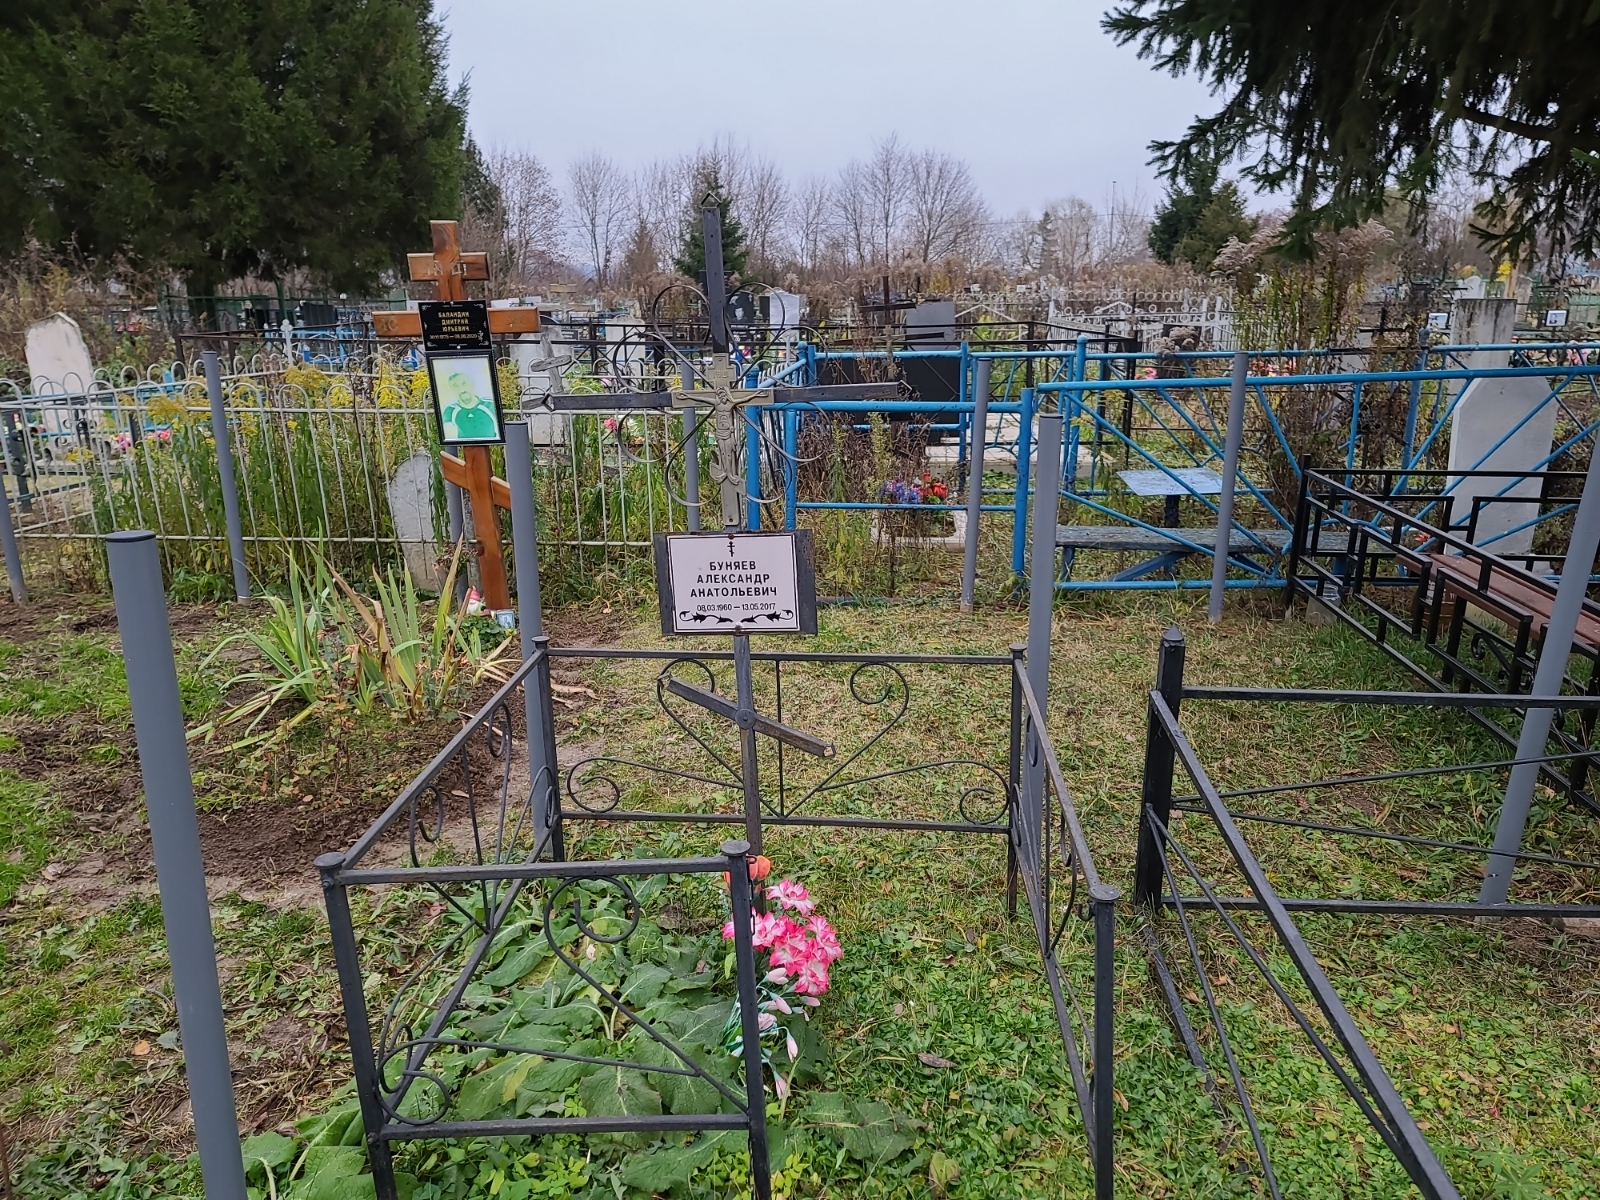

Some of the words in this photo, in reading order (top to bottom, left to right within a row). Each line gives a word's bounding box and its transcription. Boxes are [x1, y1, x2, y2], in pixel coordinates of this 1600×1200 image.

[441, 318, 469, 326] ДМИТРИЙ
[709, 560, 757, 571] БУНЯЕВ
[696, 573, 771, 585] АЛЕКСАНДР
[690, 586, 777, 598] АНАТОЛЬЕВИЧ
[696, 603, 733, 612] 08.03.1960
[741, 602, 776, 611] 13.05.2017
